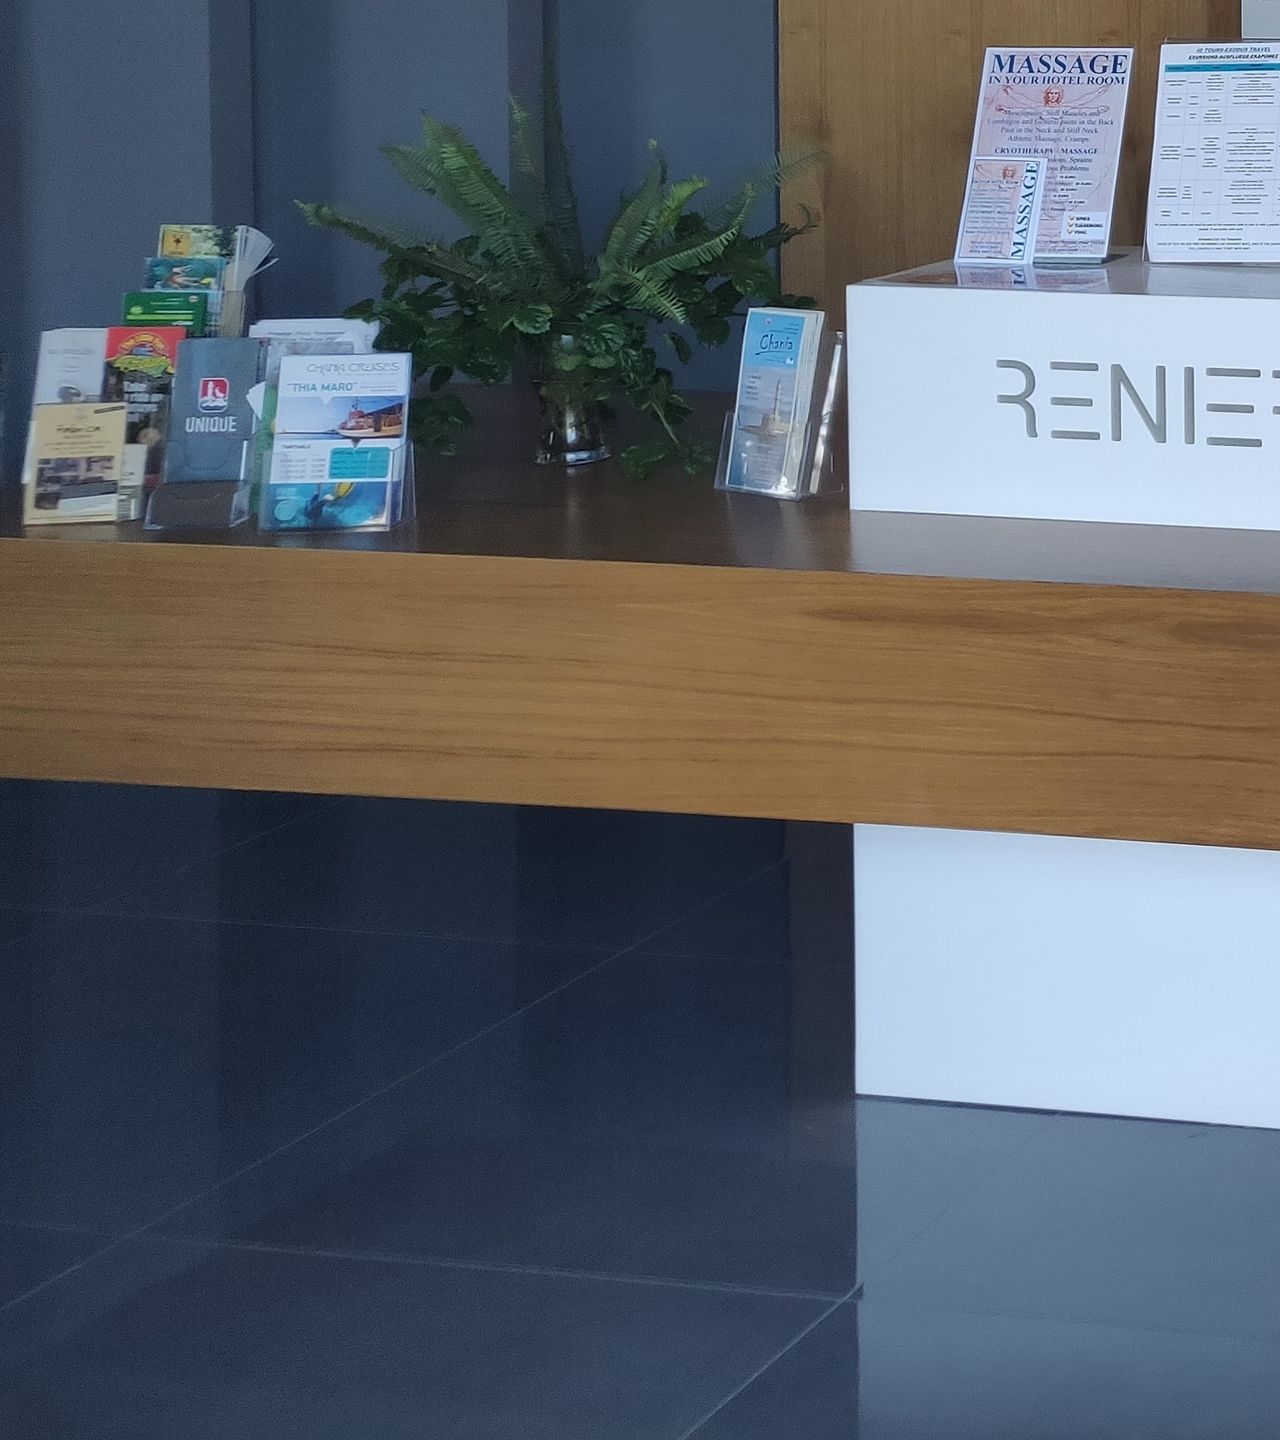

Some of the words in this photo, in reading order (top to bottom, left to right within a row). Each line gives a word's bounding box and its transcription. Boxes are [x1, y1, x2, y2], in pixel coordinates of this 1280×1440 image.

[990, 53, 1128, 74] MASSAGE
[988, 76, 1001, 85] IN
[1004, 76, 1039, 85] YOUR
[1042, 76, 1084, 85] HOTEL
[1087, 76, 1125, 85] ROOM
[1098, 118, 1114, 126] Back
[1060, 147, 1098, 155] MASSAGE
[1010, 162, 1039, 258] MASSAGE
[759, 333, 794, 351] Chania
[349, 362, 400, 372] CRUISES
[185, 416, 238, 433] UNIQUE
